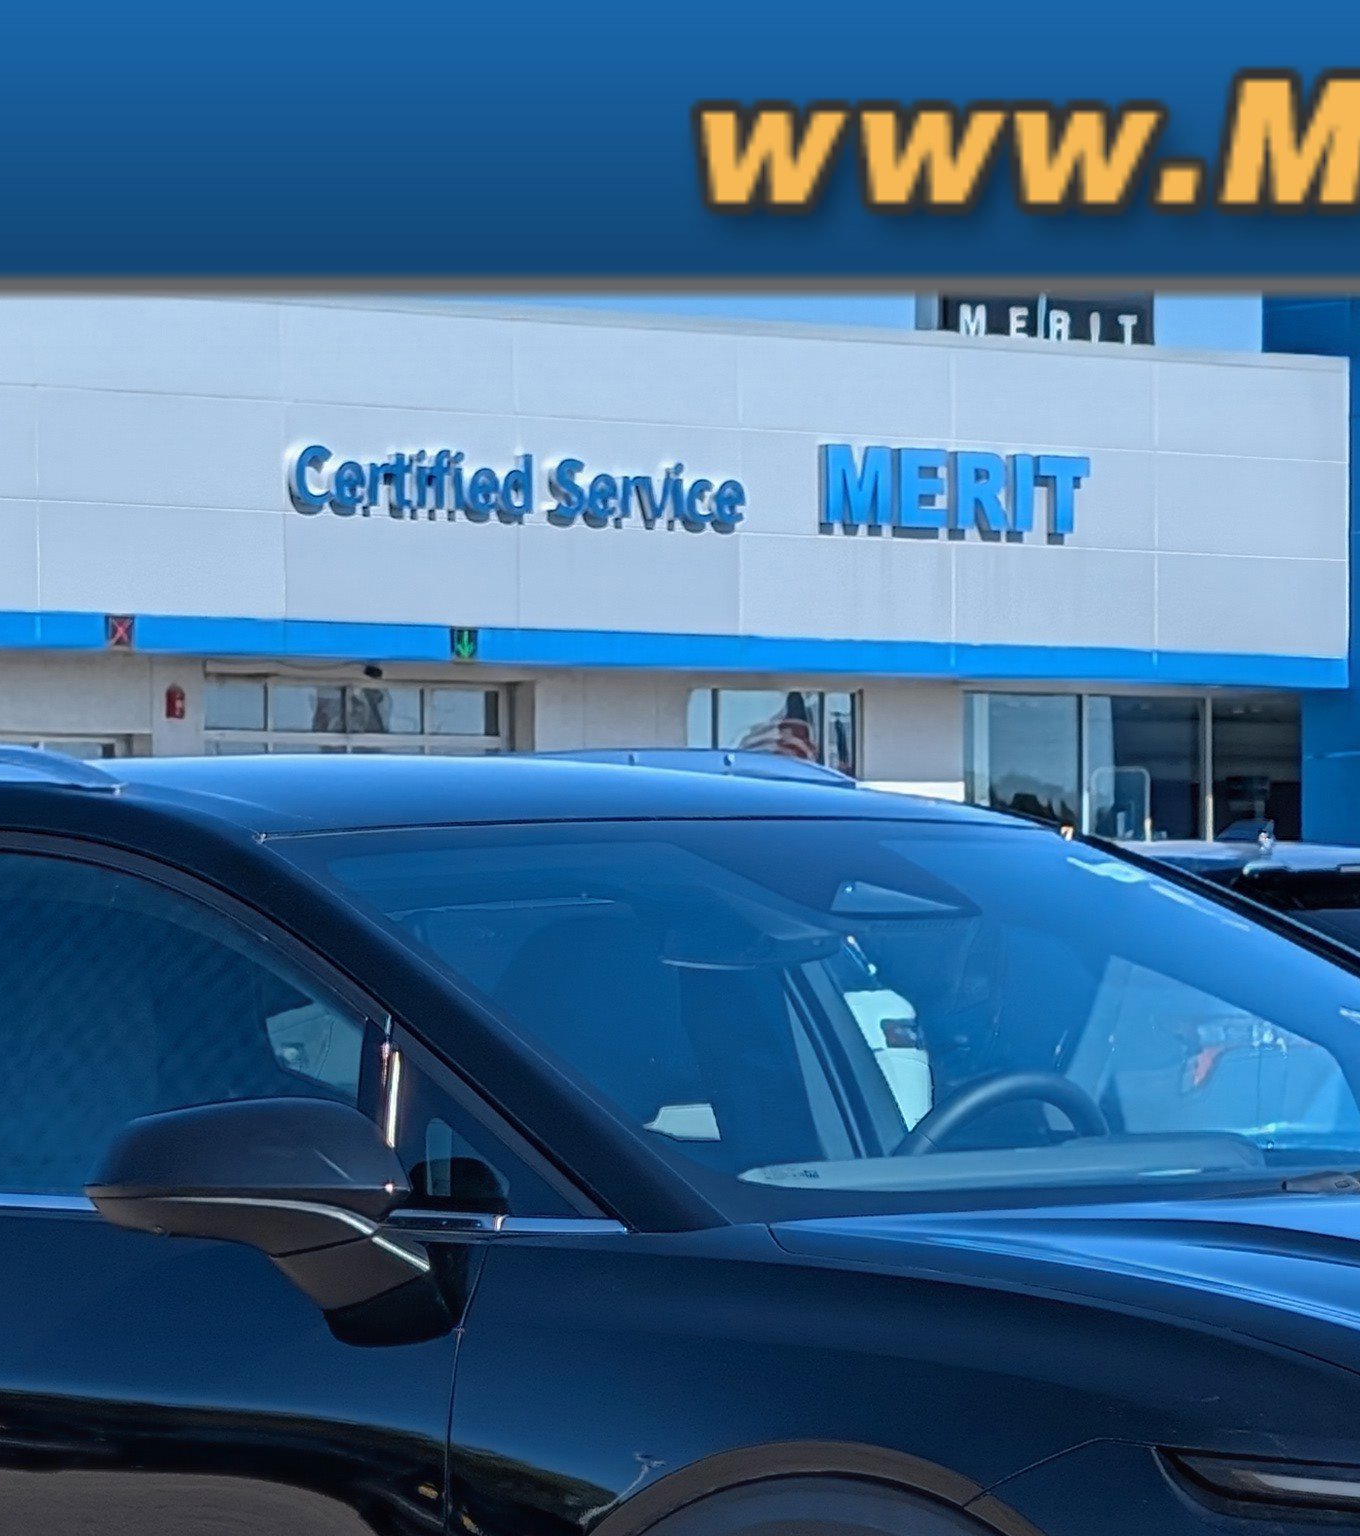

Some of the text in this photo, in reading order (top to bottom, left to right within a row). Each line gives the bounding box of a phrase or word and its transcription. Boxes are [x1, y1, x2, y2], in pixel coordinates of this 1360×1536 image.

[959, 303, 1139, 346] MERIT
[291, 445, 746, 525] Certified Service
[820, 443, 1091, 540] MERIT
